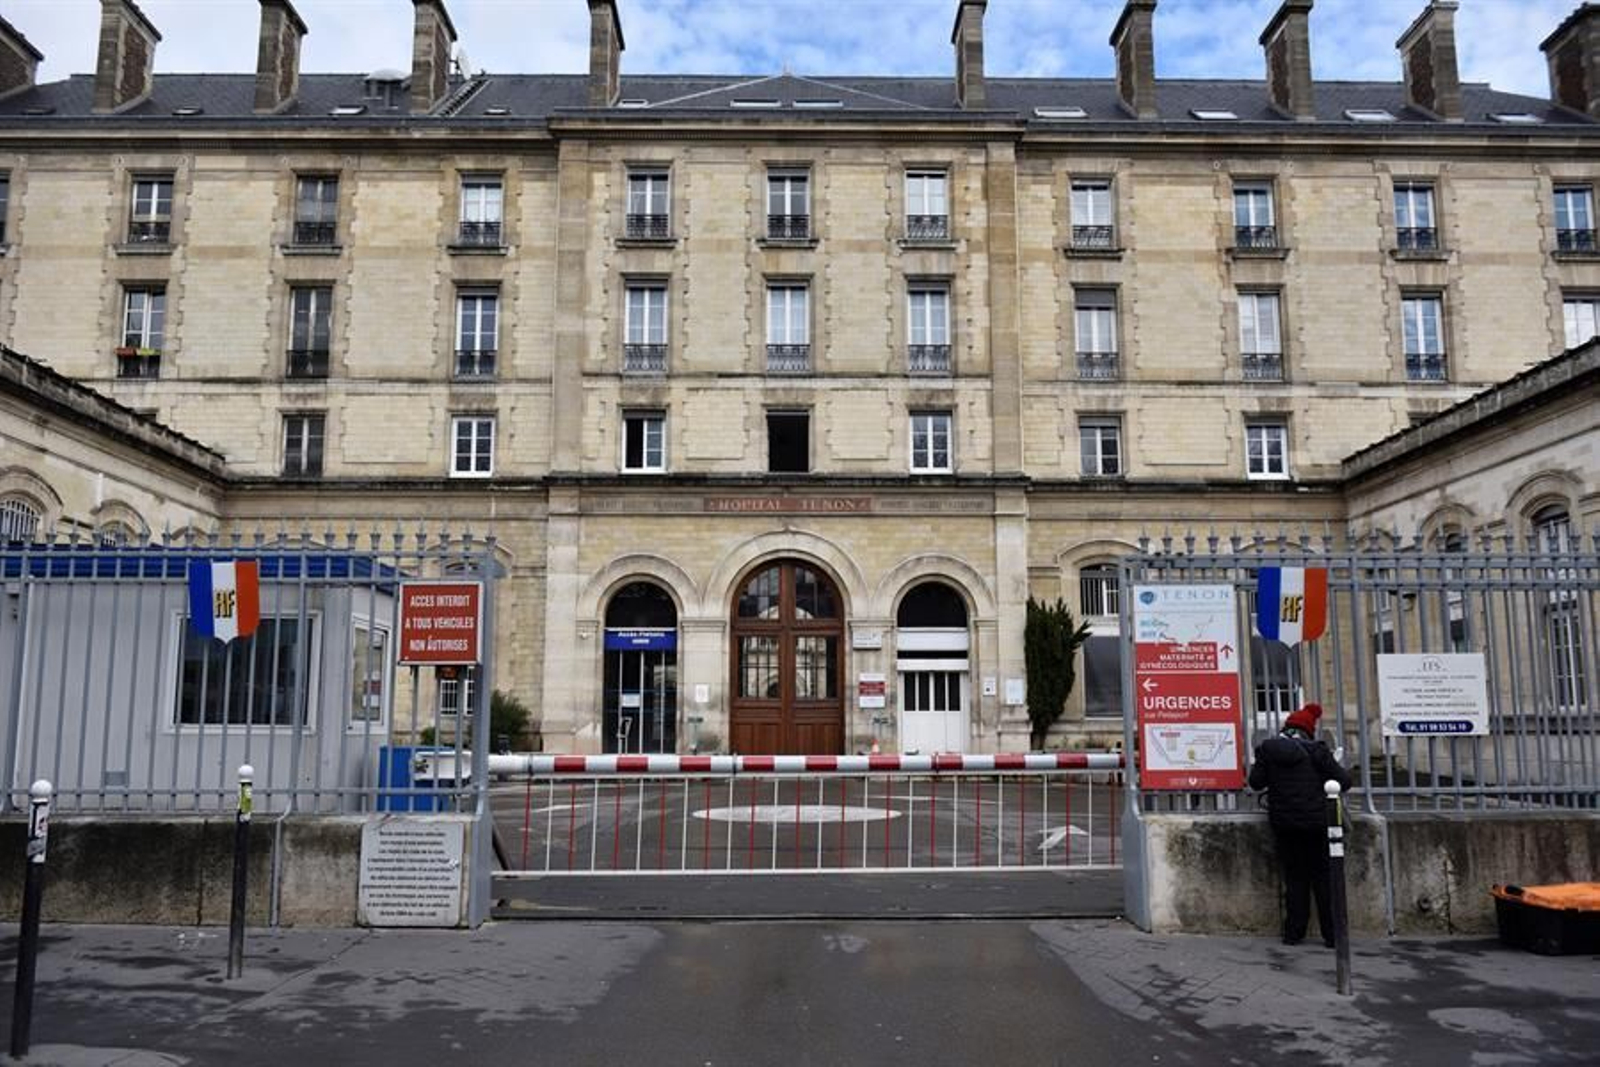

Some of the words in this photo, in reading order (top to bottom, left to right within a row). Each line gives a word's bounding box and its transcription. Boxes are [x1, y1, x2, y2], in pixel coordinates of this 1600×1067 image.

[437, 594, 470, 607] INTERDIT
[1163, 589, 1229, 600] TENON
[215, 589, 235, 618] RF
[1281, 596, 1303, 623] RF
[412, 616, 432, 629] TOUS
[410, 639, 425, 652] NON
[1143, 696, 1232, 710] URGENCES
